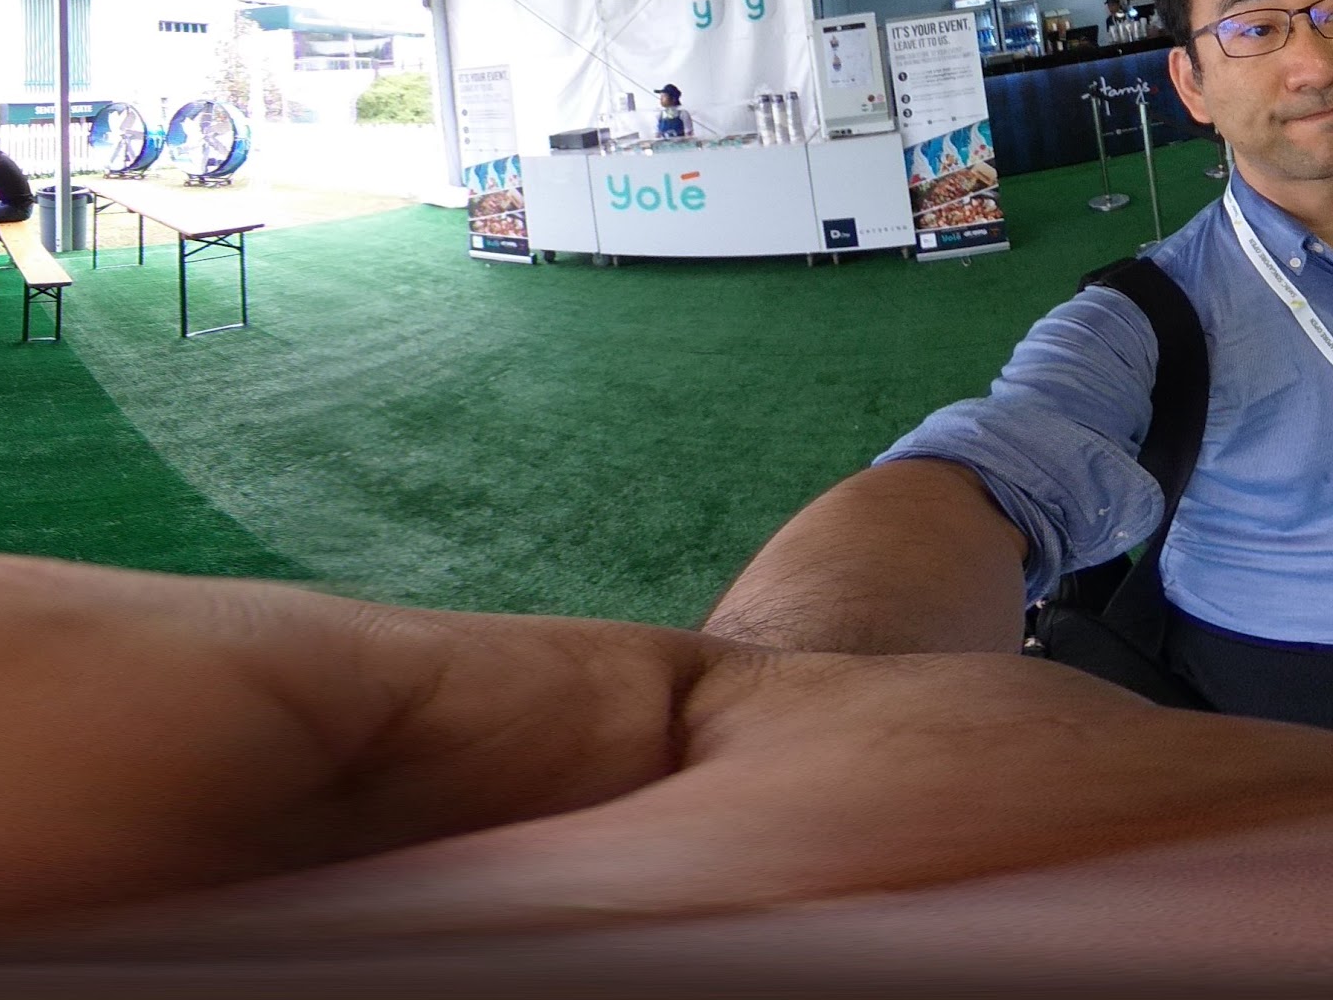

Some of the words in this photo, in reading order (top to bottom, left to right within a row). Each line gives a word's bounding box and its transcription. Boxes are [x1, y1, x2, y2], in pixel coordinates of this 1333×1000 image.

[892, 25, 910, 40] IT'S
[911, 23, 937, 37] YOUR
[938, 18, 972, 34] EVENT,
[893, 40, 917, 52] LEAVE
[918, 38, 926, 48] IT
[927, 37, 937, 47] TO
[1248, 237, 1261, 255] OPEN
[1259, 253, 1284, 286] SINGAPORE
[1309, 316, 1323, 334] OPEN
